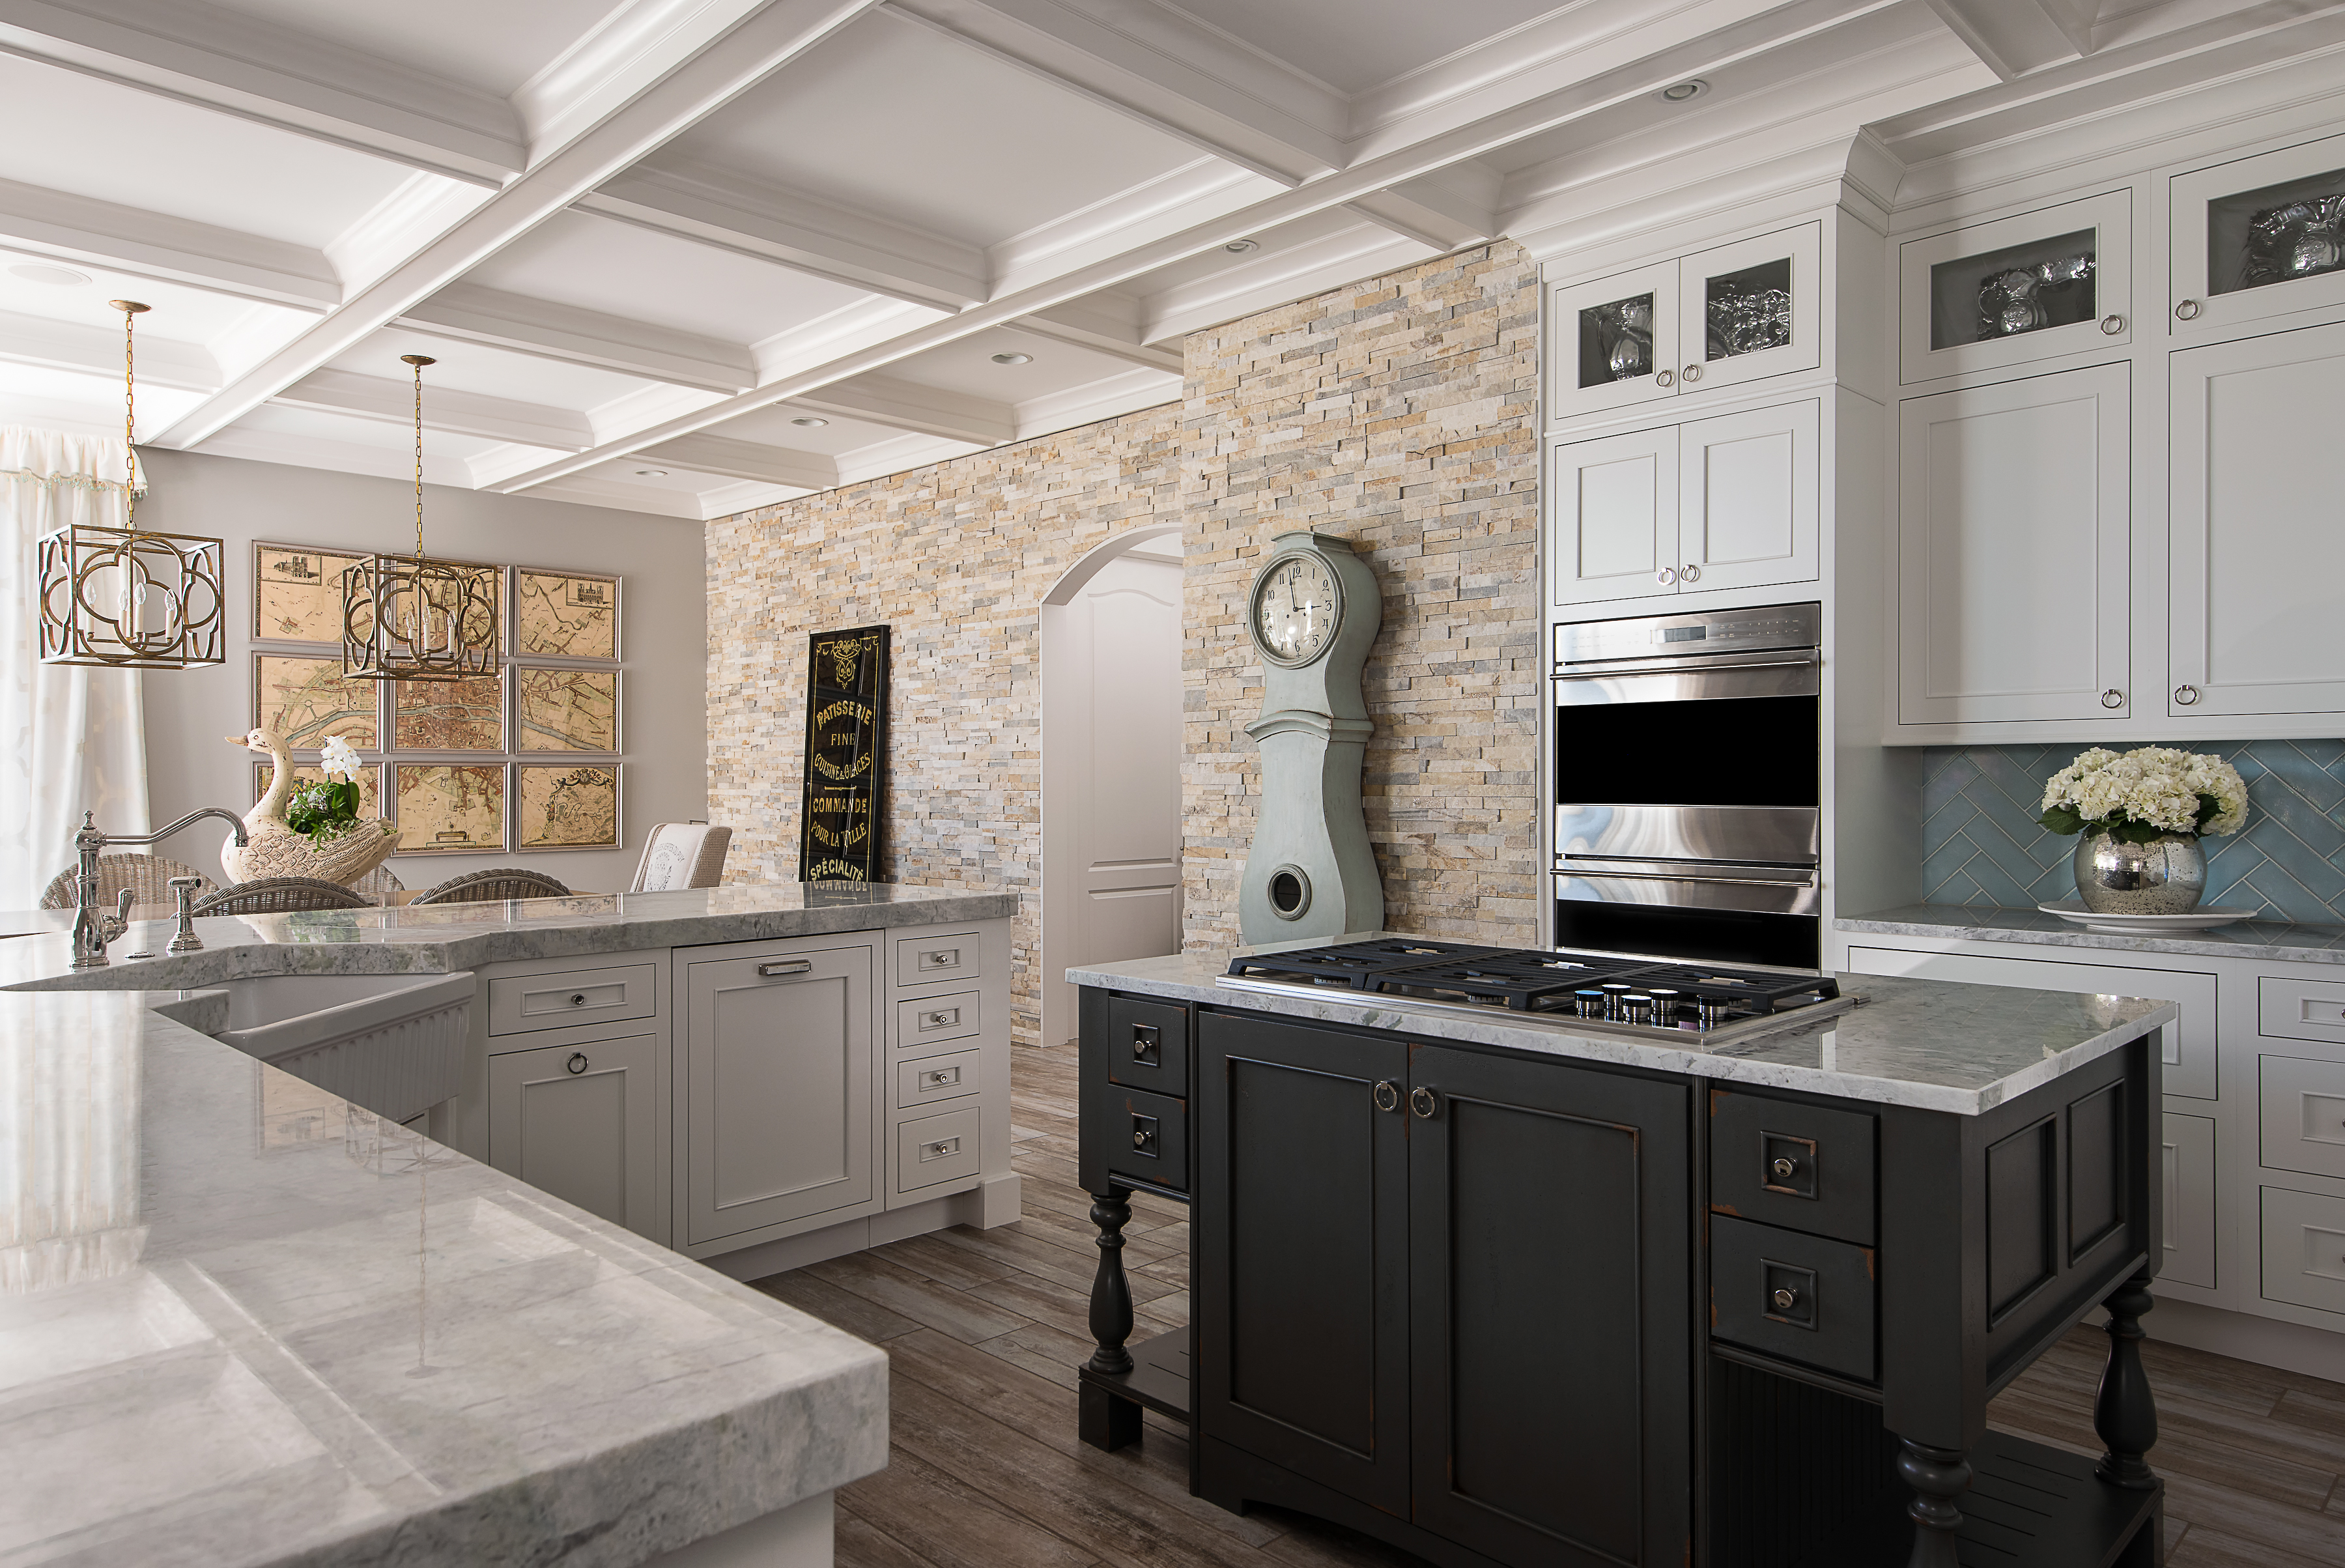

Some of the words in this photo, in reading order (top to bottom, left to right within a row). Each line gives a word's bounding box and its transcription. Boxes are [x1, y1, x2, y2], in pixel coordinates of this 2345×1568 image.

[1293, 566, 1301, 578] 12
[1313, 568, 1315, 579] 1
[1279, 573, 1284, 584] 11
[1322, 579, 1329, 592] 2
[1268, 590, 1275, 601] 10
[1325, 599, 1332, 611] 3
[1321, 617, 1329, 630] 4
[1295, 640, 1300, 651] 6
[1313, 634, 1319, 647] 5
[831, 734, 855, 746] FINE
[814, 753, 840, 780] CUISINE
[840, 770, 846, 780] &
[844, 752, 870, 780] GLACES
[813, 797, 867, 813] COMMANDE
[811, 820, 829, 845] POUR
[831, 832, 840, 848] LA
[840, 822, 866, 848] VILLE
[810, 857, 863, 882] SPÉCIALITÉ
